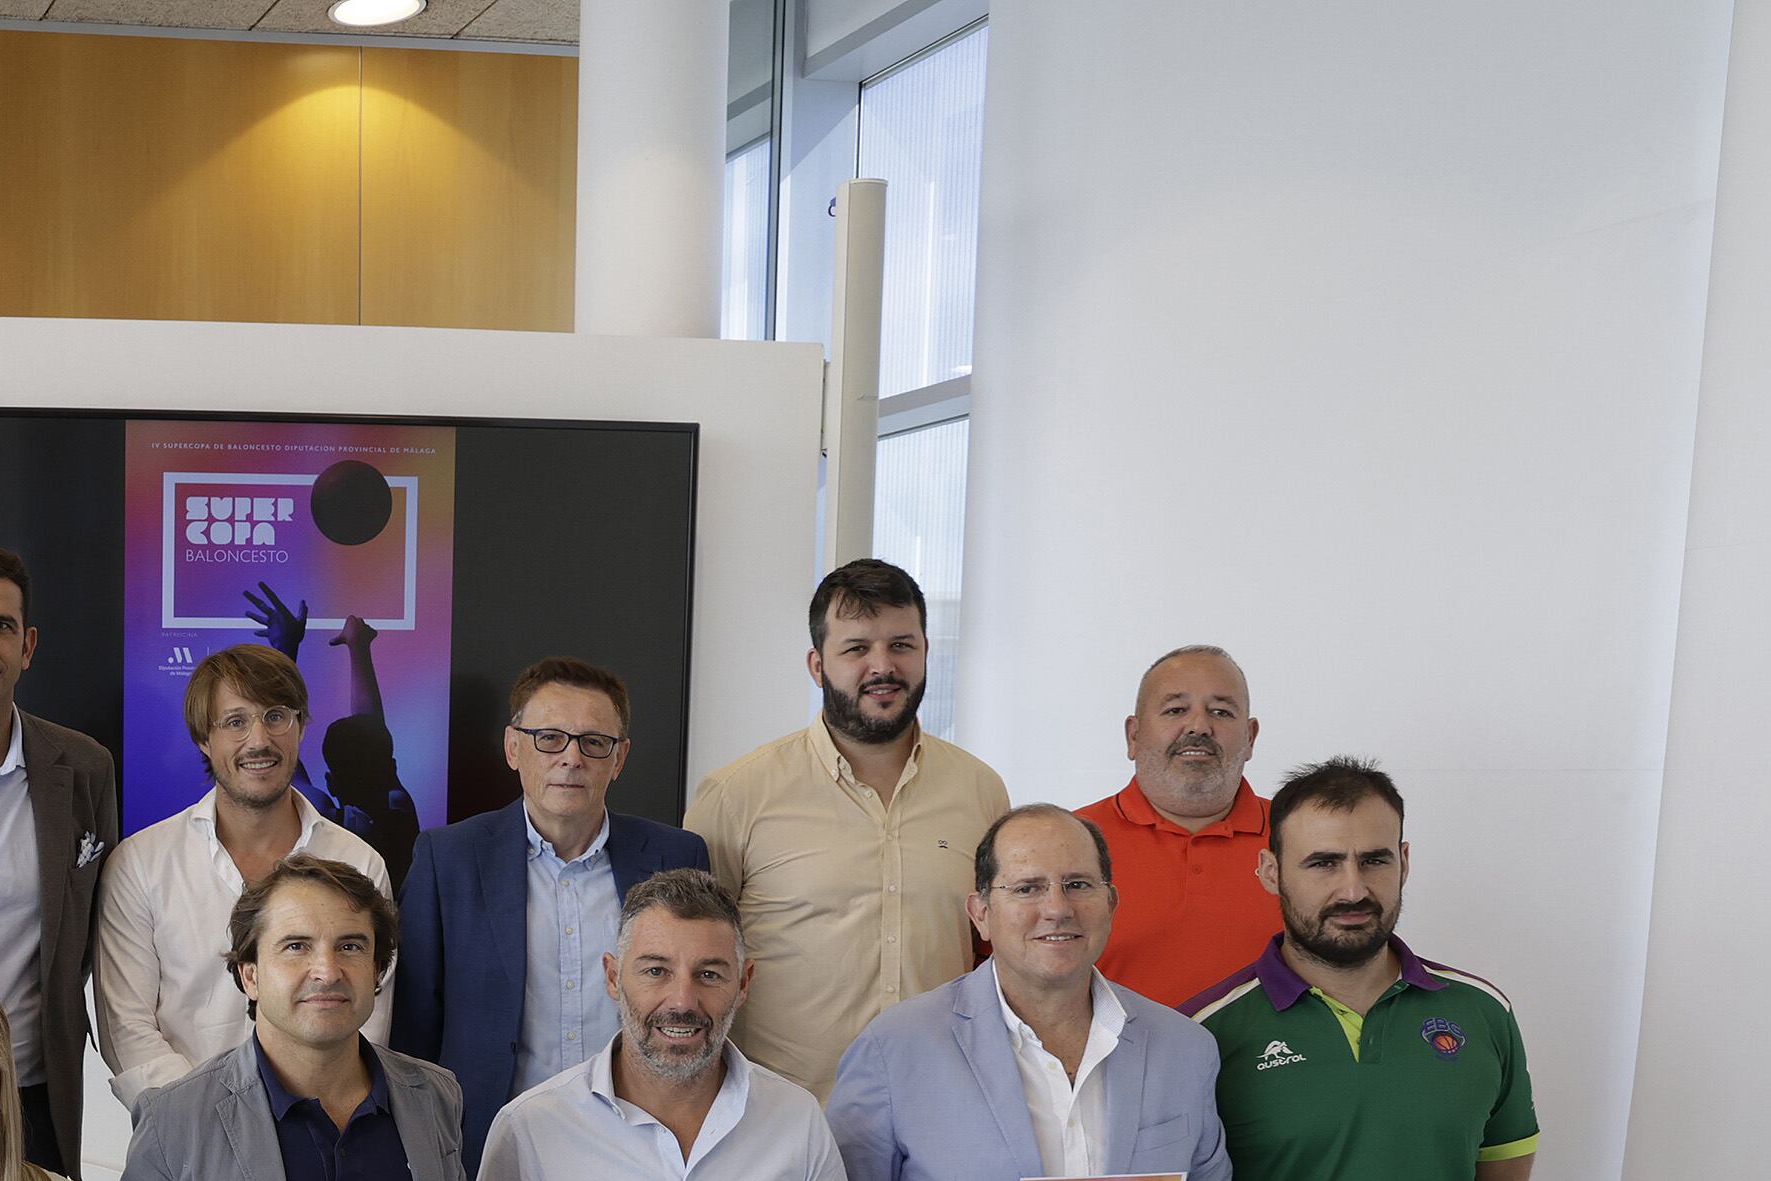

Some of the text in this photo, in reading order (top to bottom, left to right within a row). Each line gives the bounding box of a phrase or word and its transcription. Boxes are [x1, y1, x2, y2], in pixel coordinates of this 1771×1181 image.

[227, 443, 282, 451] BALONCESTO
[185, 496, 294, 521] SUPER
[185, 521, 275, 546] COPA
[185, 549, 289, 563] BALONCESTO
[1422, 1017, 1464, 1036] EBC
[1257, 1054, 1307, 1071] austral
